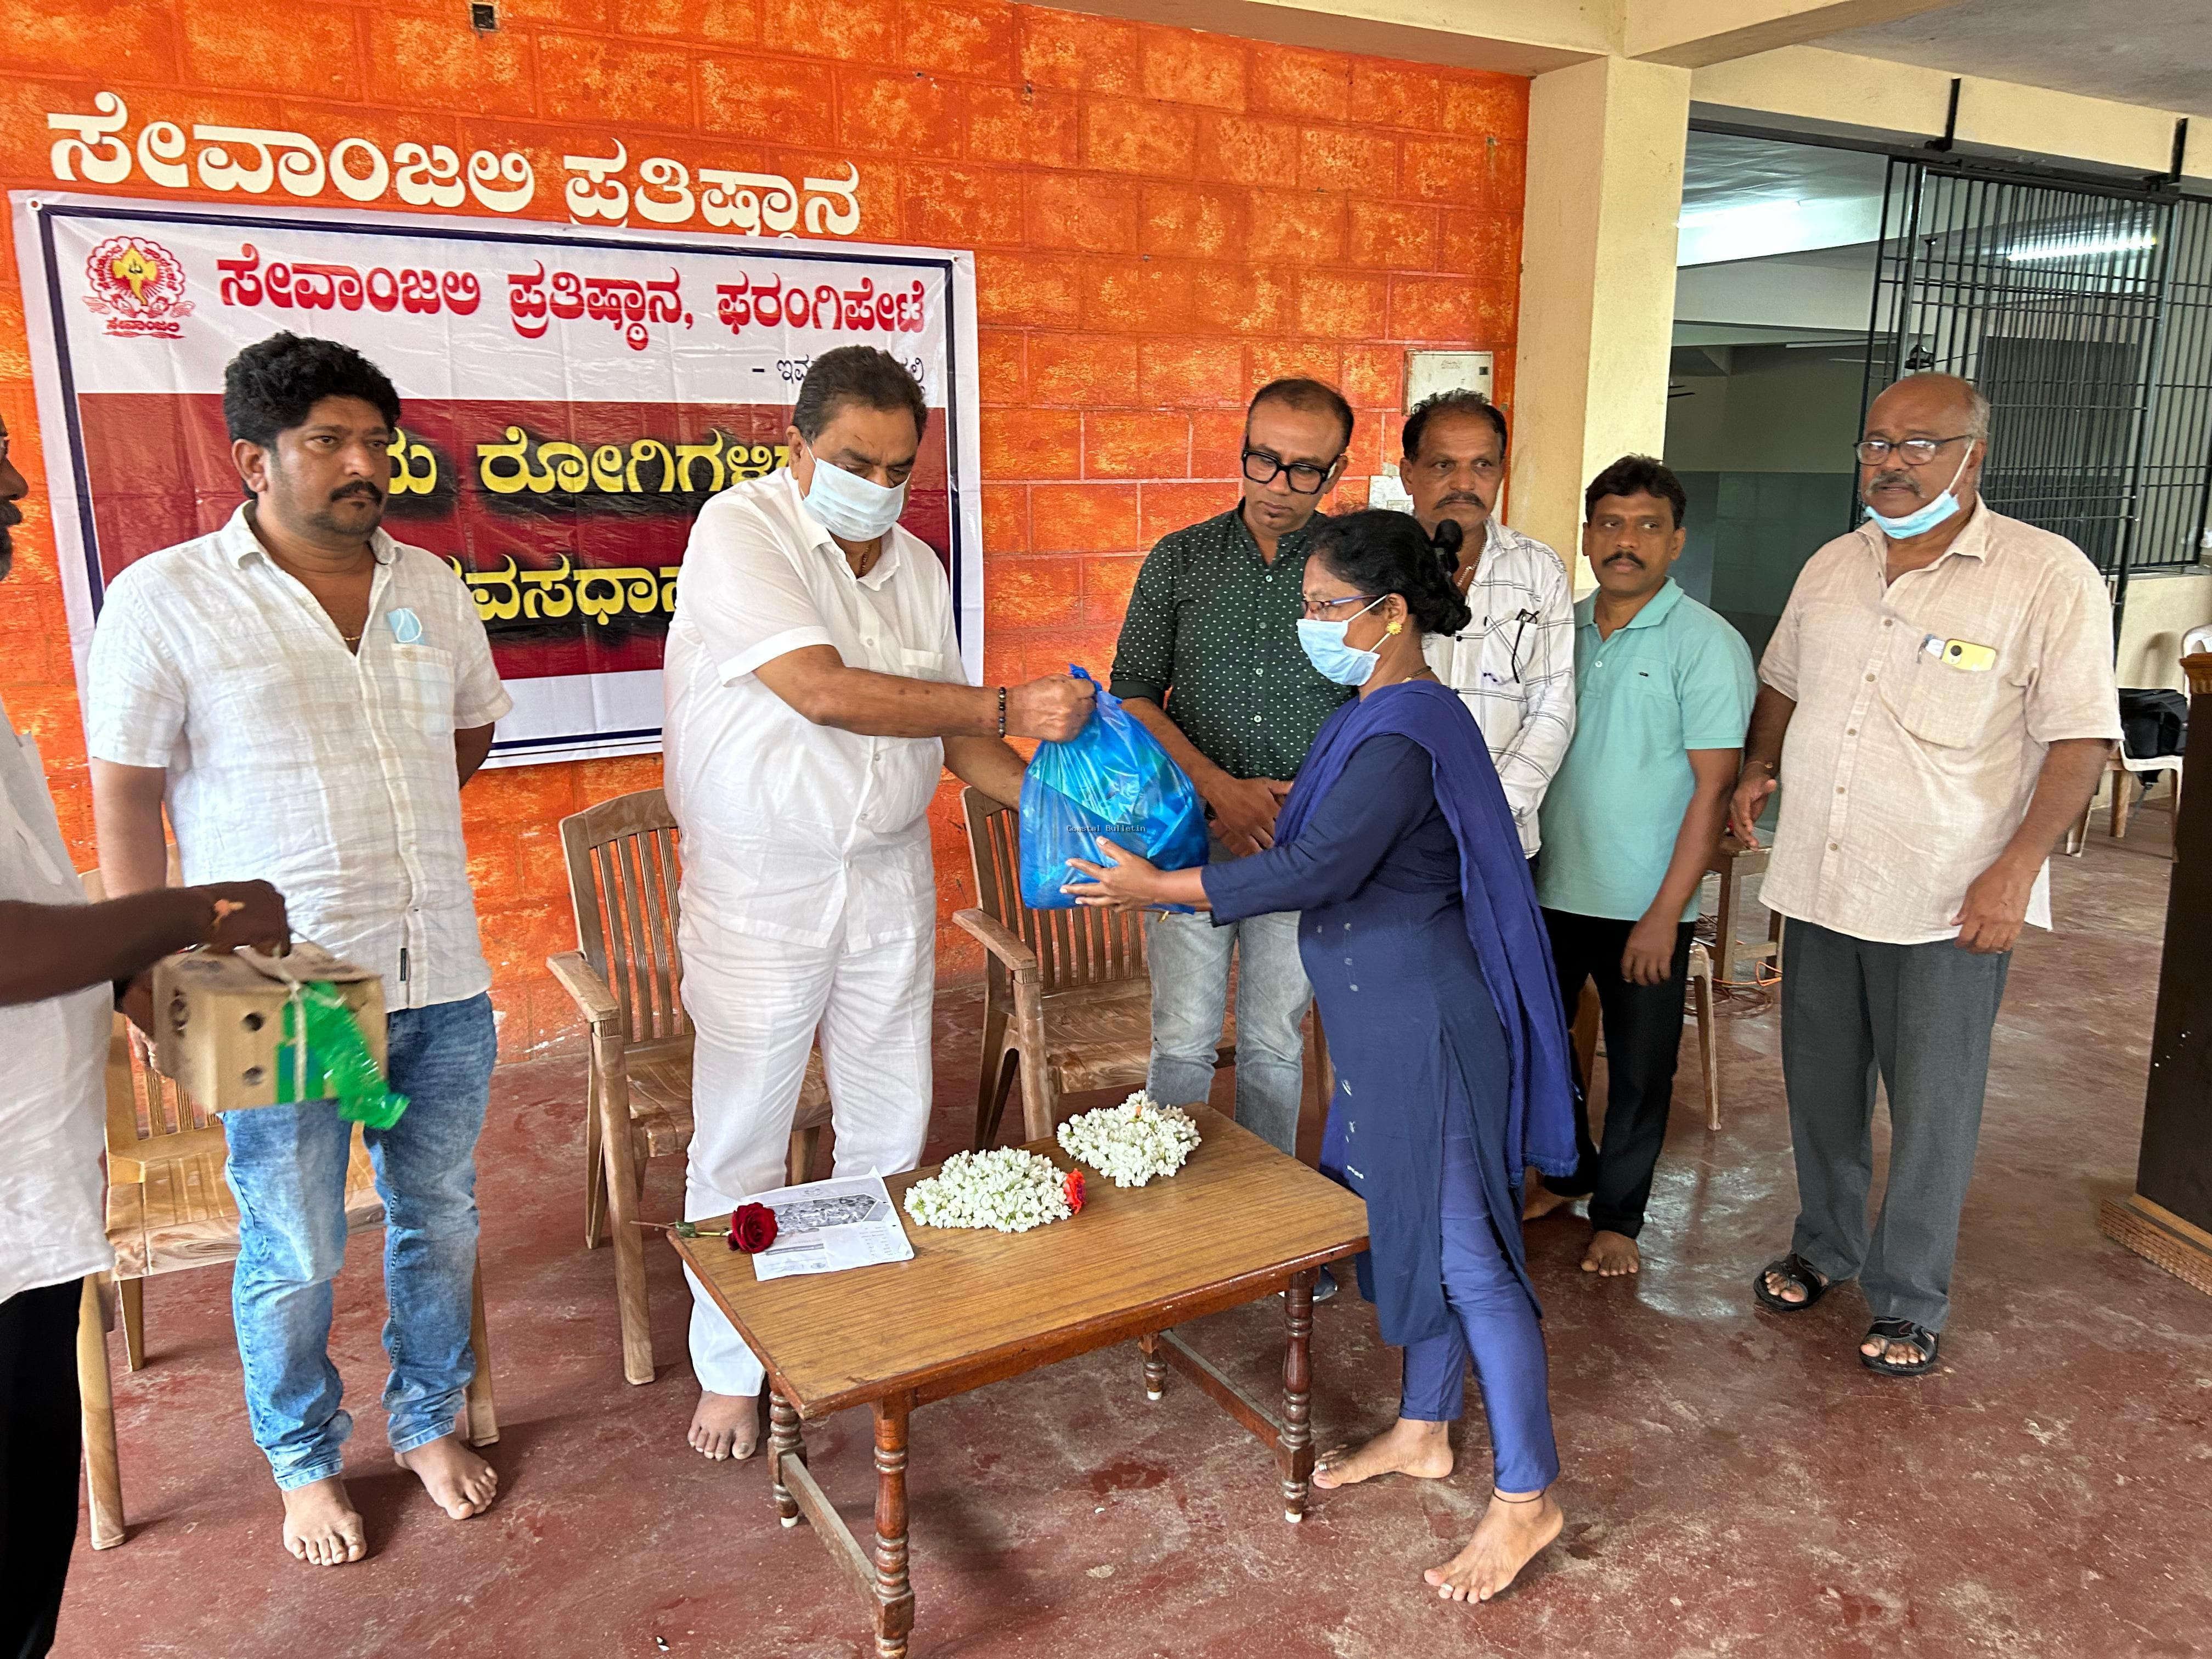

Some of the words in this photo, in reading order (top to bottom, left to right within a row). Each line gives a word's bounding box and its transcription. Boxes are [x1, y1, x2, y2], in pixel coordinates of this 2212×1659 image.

[47, 92, 535, 212] ಸೇವಾಂಜಲಿ
[217, 242, 481, 315] ಸೇವಾಂಜಲಿ
[507, 259, 693, 351] ಪ್ರತಿಷ್ಠಾನ,
[716, 270, 925, 334] ಫರಂಗಿಪೇಟೆ
[446, 552, 681, 625] ವಸಧಾ
